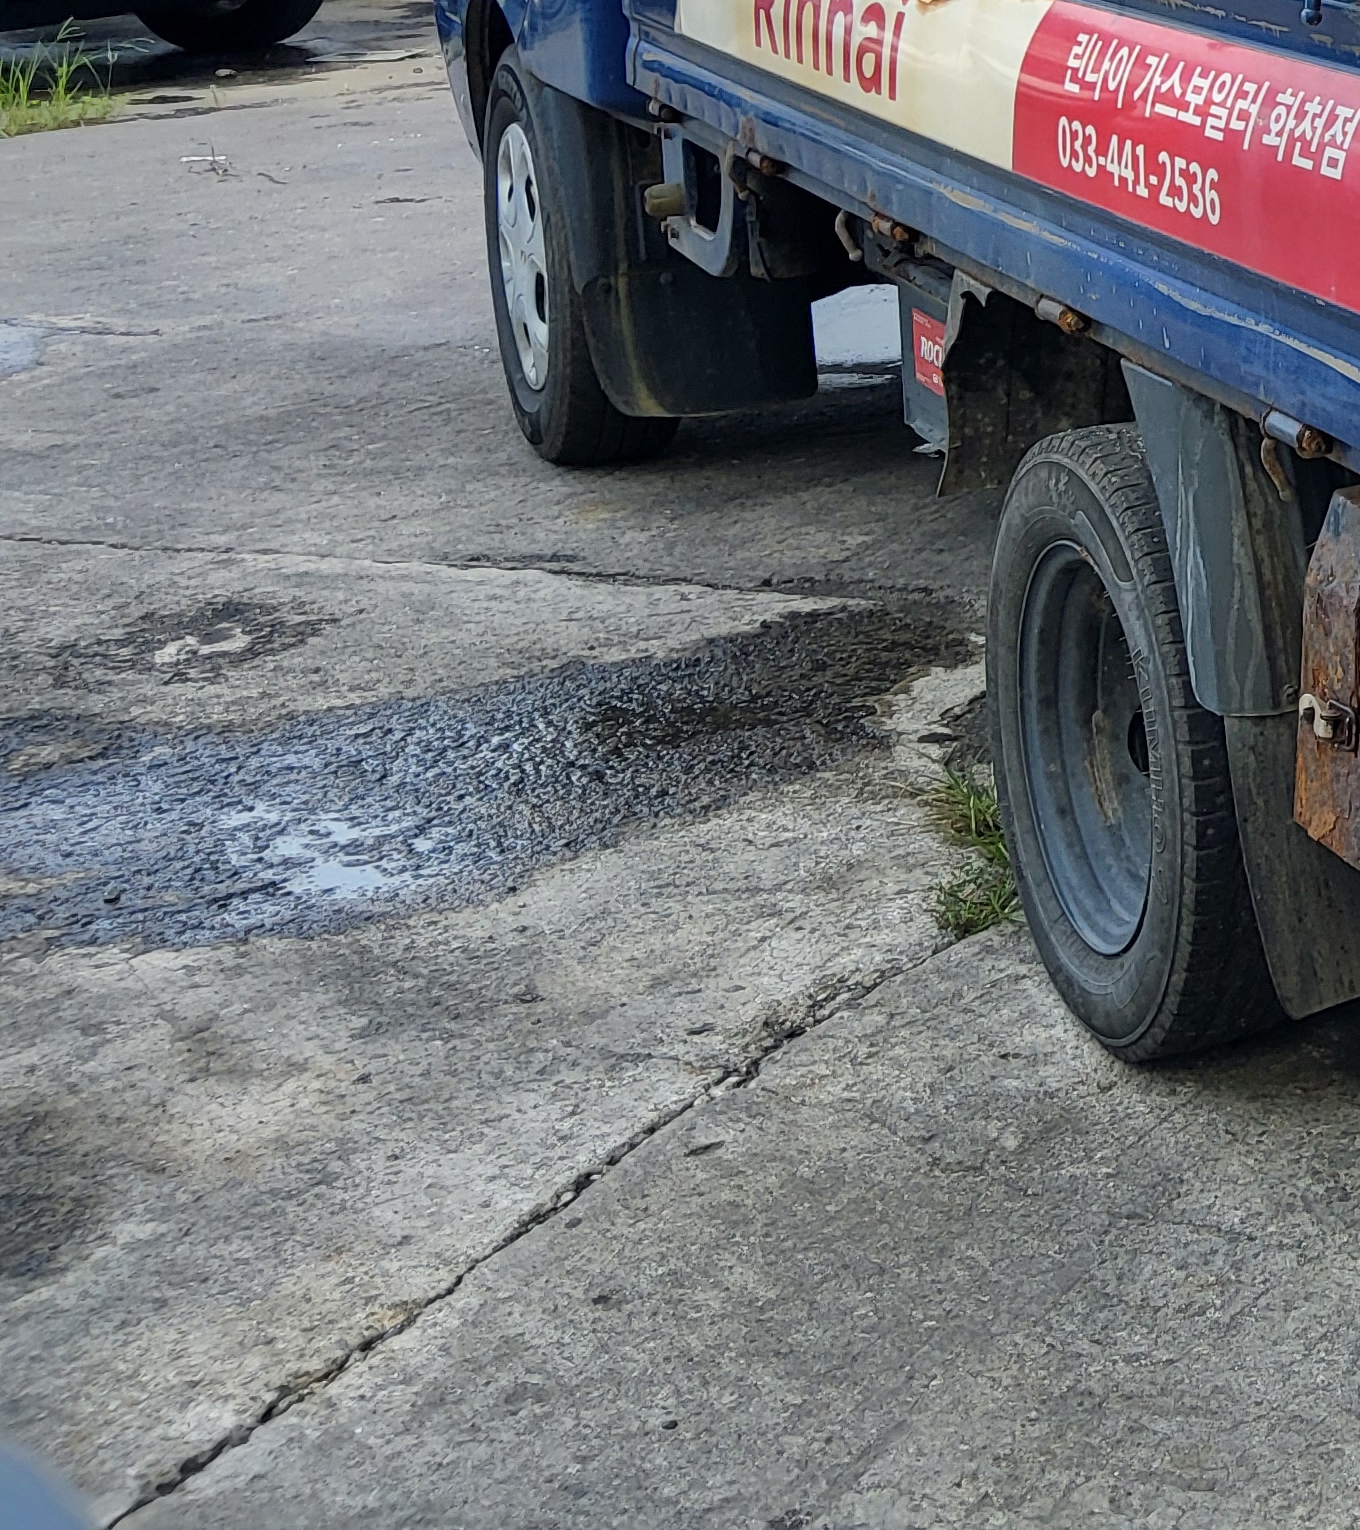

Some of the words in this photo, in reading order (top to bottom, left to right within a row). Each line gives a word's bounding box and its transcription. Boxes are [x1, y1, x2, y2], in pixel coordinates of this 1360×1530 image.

[1063, 32, 1142, 109] 린나이
[1133, 52, 1271, 151] 가스보일러
[1057, 115, 1221, 226] 033-441-2536
